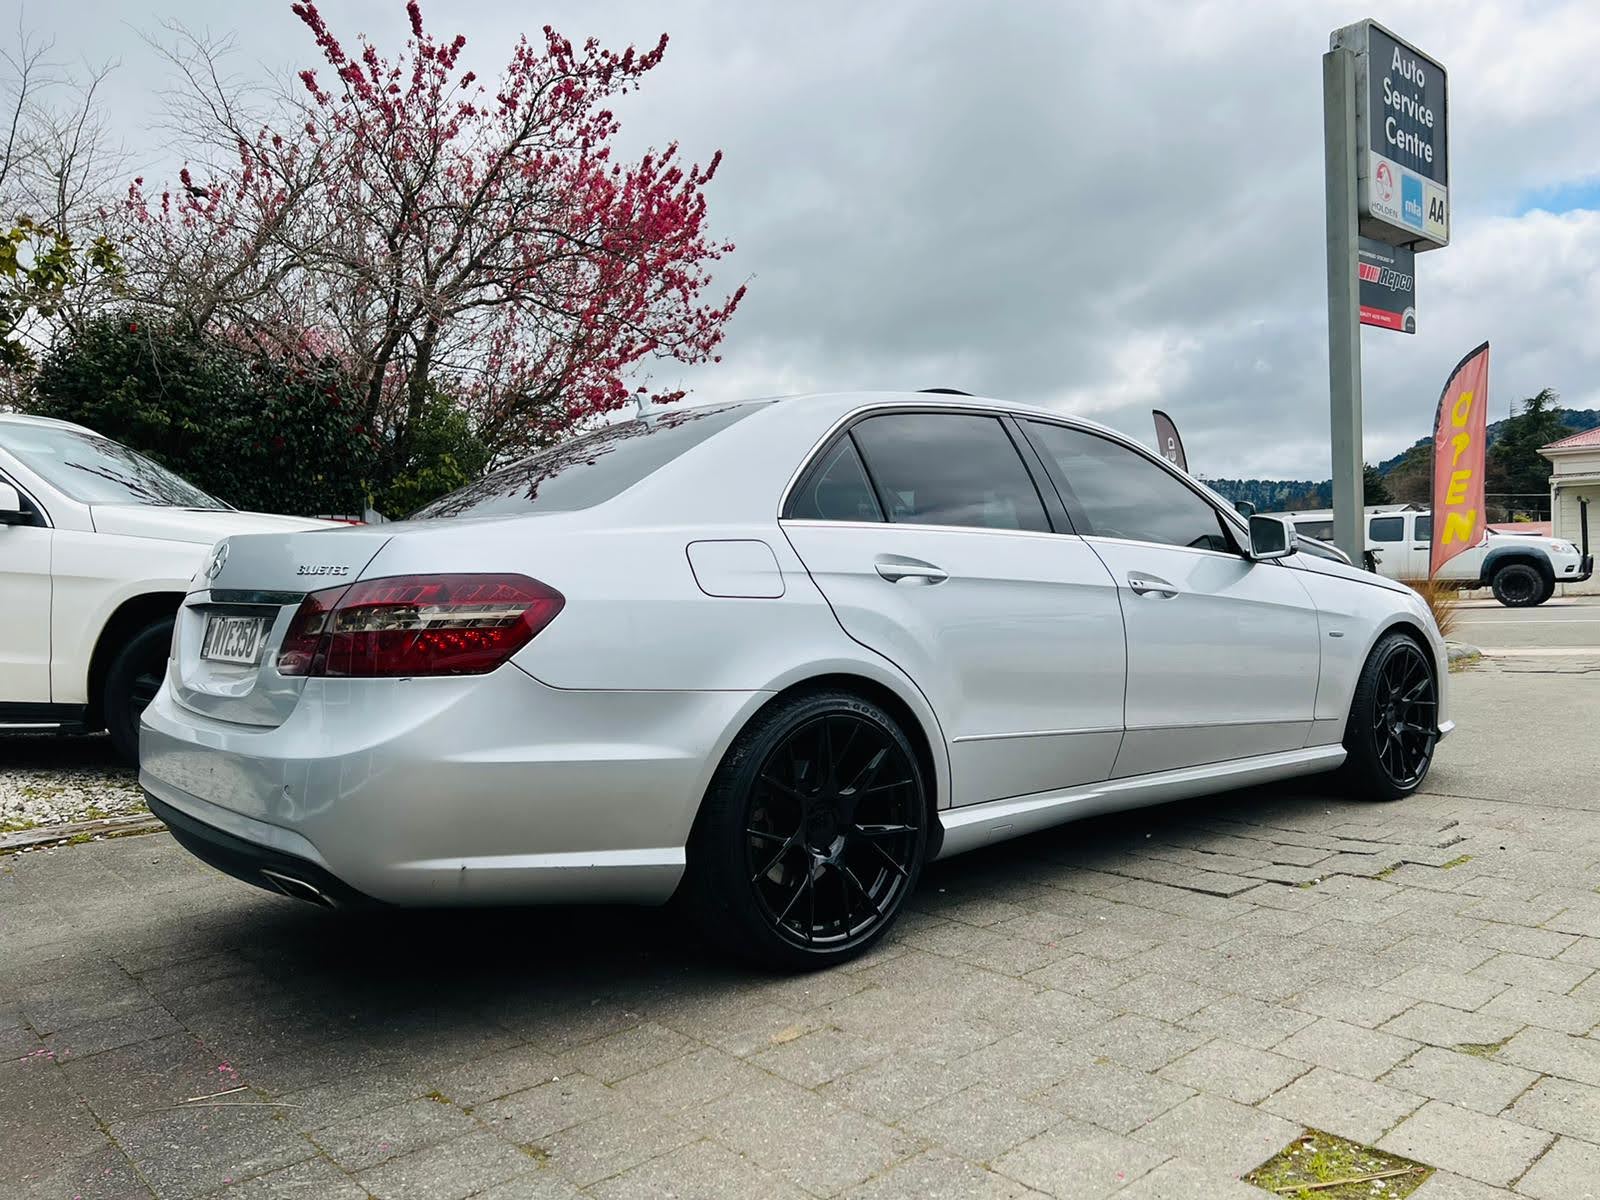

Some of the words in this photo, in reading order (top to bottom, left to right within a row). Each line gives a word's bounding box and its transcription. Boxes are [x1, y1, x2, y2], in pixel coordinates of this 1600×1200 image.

[1391, 46, 1425, 88] Auto
[1383, 76, 1434, 128] Service
[1385, 115, 1433, 163] Centre
[1371, 202, 1398, 218] HOLDEN
[1428, 197, 1444, 225] AA
[1442, 391, 1477, 545] OPEN
[296, 564, 350, 576] BLUETEC
